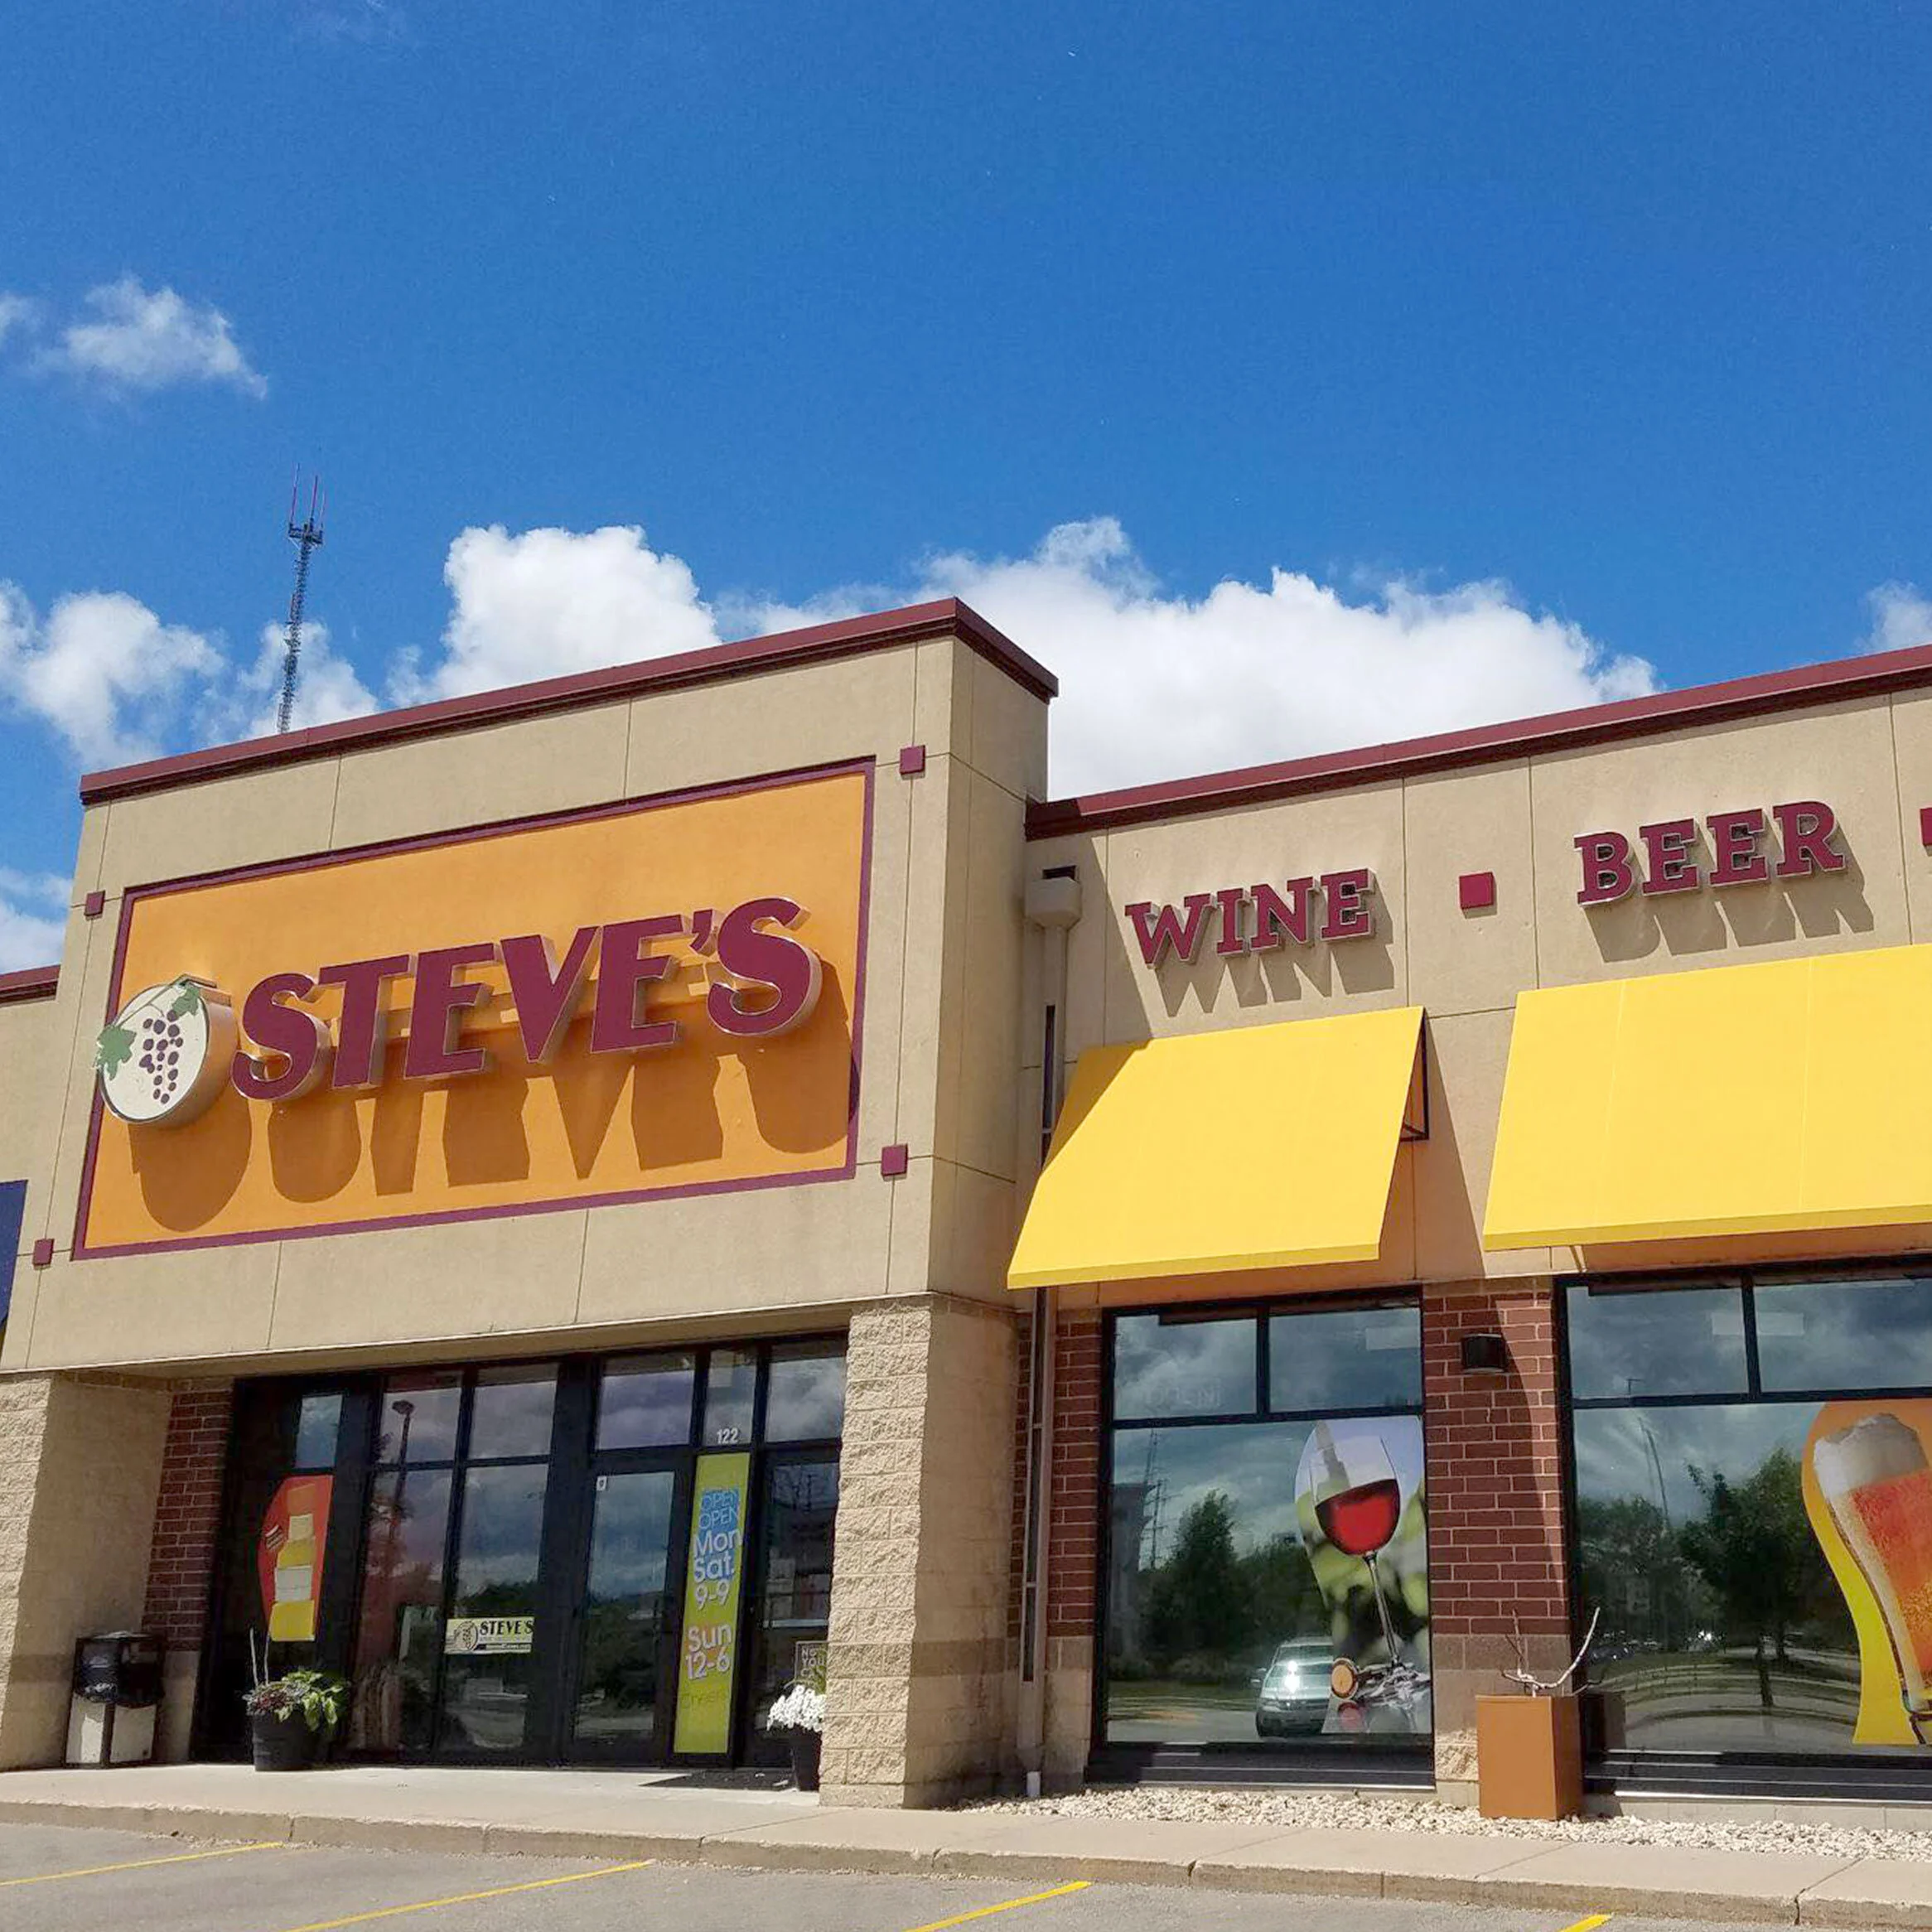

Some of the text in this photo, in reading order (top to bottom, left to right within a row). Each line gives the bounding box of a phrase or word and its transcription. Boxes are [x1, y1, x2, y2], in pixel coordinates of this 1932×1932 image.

[1124, 800, 1846, 969] WINE BEER
[229, 896, 822, 1102] STEVE'S
[716, 1427, 740, 1444] 122
[693, 1528, 741, 1558] Mon
[694, 1577, 731, 1611] 9-9
[480, 1620, 534, 1635] STEVE'S
[688, 1624, 732, 1653] Sun
[686, 1647, 731, 1680] 12-6
